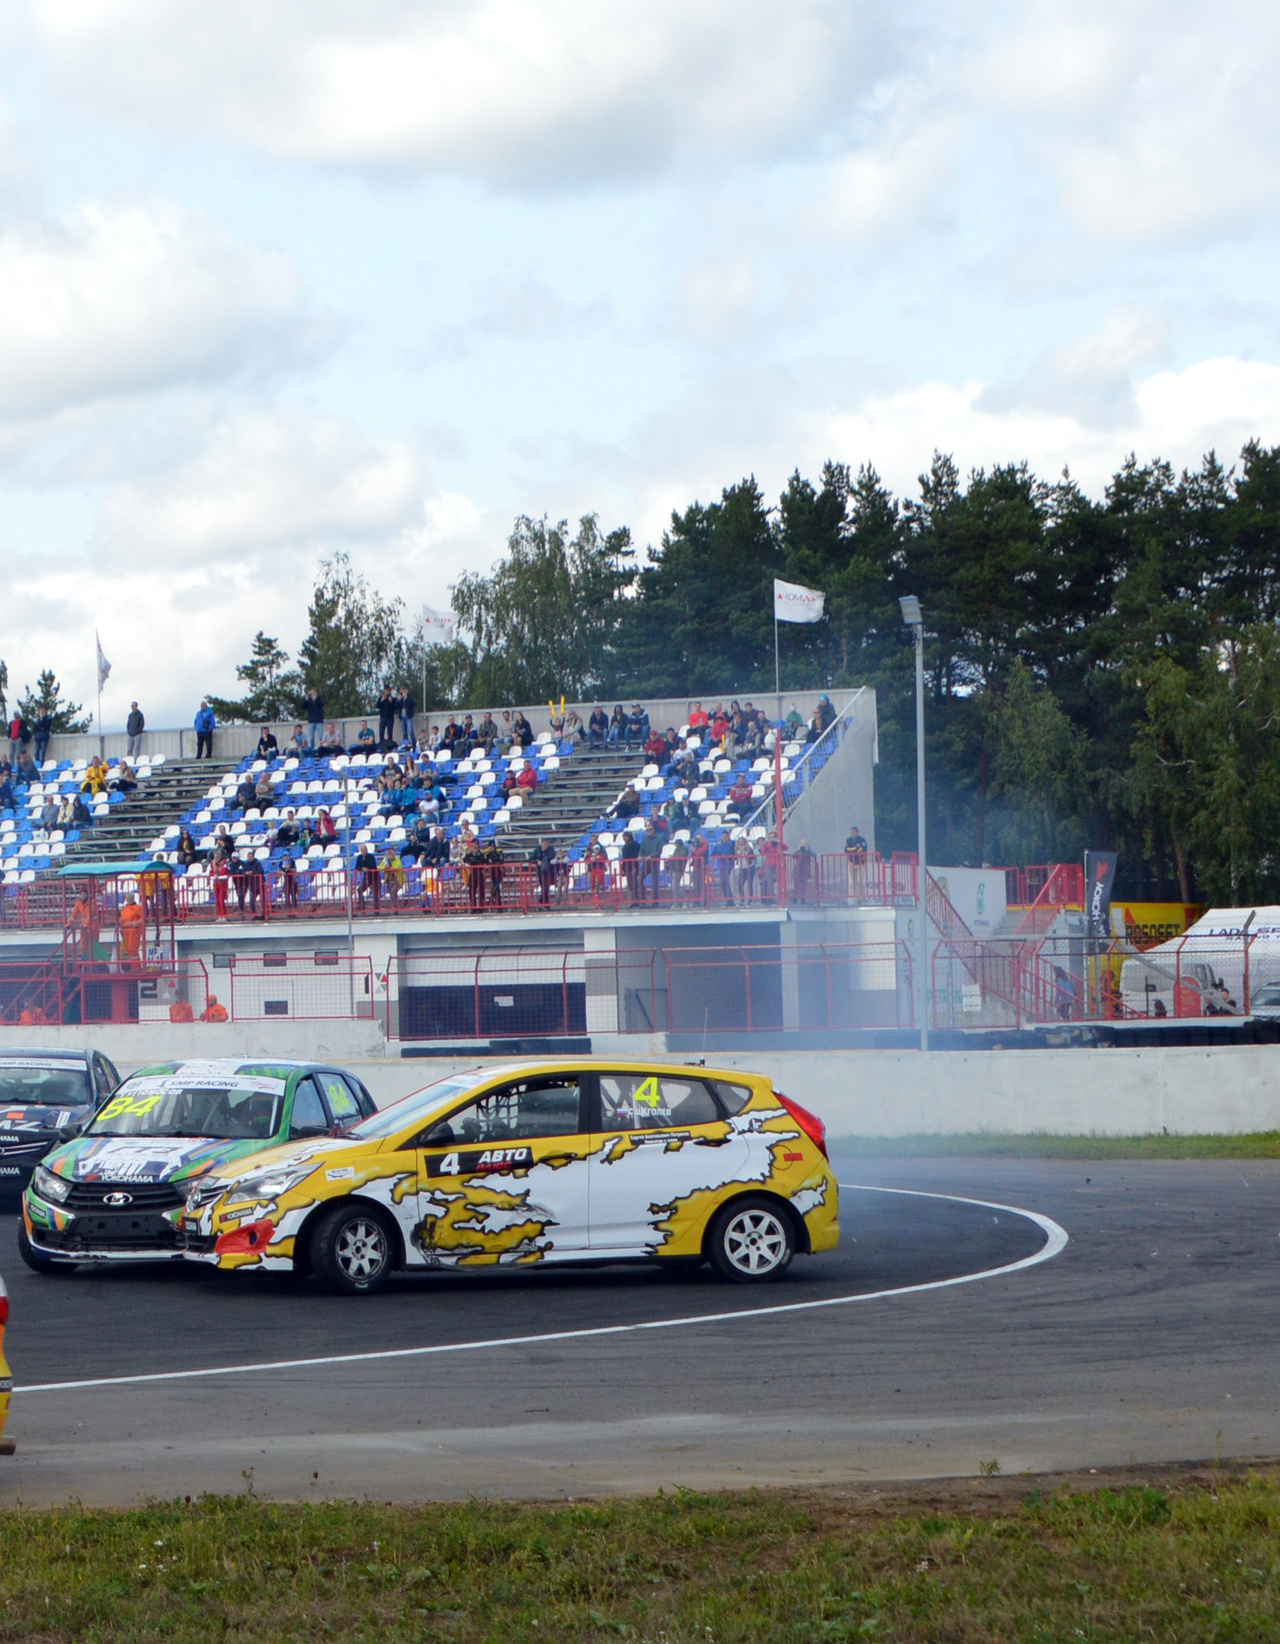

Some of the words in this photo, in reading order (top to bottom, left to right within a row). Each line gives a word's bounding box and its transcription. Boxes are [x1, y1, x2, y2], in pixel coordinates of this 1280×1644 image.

[140, 979, 158, 999] 2
[195, 1080, 239, 1088] RACING
[634, 1077, 660, 1108] 4
[96, 1096, 162, 1121] 84
[328, 1083, 349, 1114] 84
[440, 1152, 460, 1176] 4
[478, 1148, 528, 1163] АВТО
[100, 1172, 154, 1183] YOKOHAMA
[226, 1208, 253, 1219] YOKOHAMA
